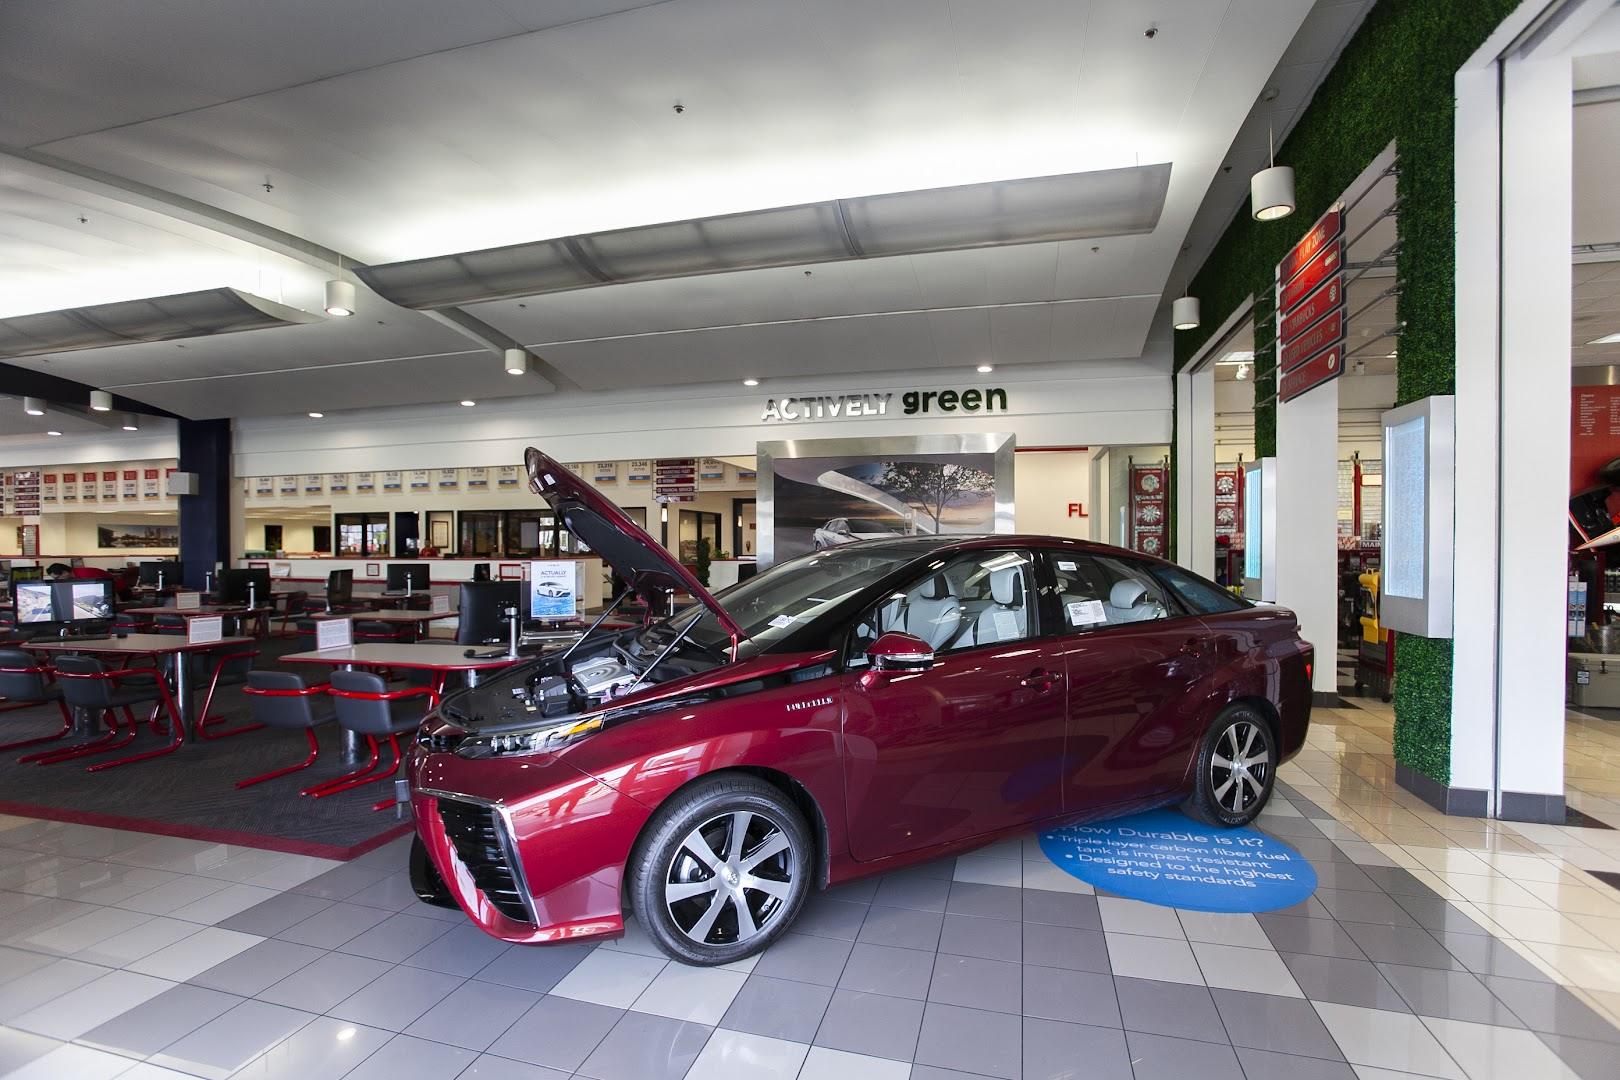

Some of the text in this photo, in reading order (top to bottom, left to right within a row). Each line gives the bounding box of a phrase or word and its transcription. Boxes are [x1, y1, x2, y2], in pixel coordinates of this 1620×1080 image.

[761, 387, 1008, 421] ACTIVELY green
[1058, 834, 1291, 861] Triple layer carbon fiber fuel
[1118, 827, 1209, 843] Durable
[1213, 835, 1233, 845] is
[1236, 836, 1264, 848] it?
[1076, 845, 1272, 869] tank is impact resistant
[1078, 853, 1295, 881] Designed to the highest
[1107, 868, 1257, 888] safety standards
